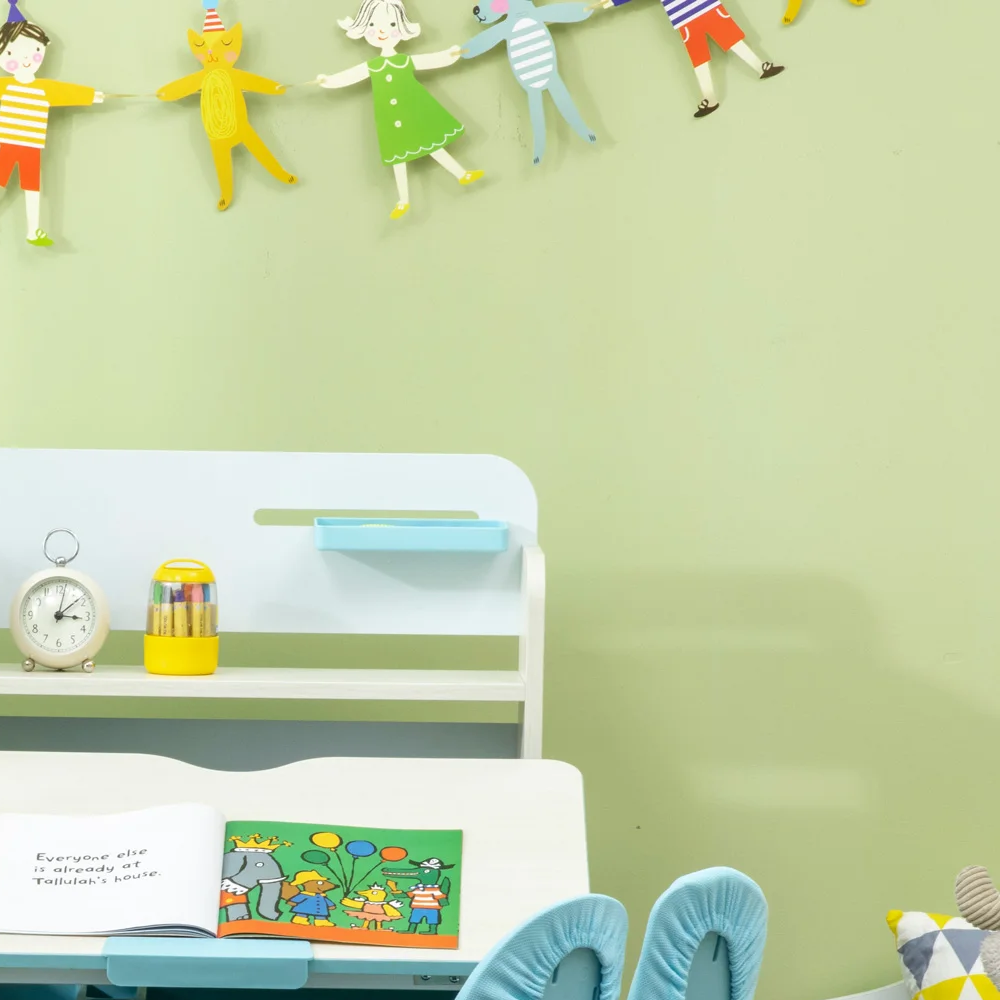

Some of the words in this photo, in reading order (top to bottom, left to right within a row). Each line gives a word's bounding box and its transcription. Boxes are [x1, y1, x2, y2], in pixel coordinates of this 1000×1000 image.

[55, 585, 64, 595] 12
[80, 598, 86, 607] 2
[27, 610, 34, 621] 9
[84, 611, 91, 622] 3
[31, 623, 39, 633] 8
[80, 624, 86, 633] 4
[43, 633, 49, 643] 7
[56, 638, 62, 648] 6
[70, 634, 76, 644] 5
[36, 853, 110, 863] Everyone
[117, 848, 148, 859] else
[53, 864, 115, 874] already
[122, 860, 142, 869] at
[32, 876, 107, 886] Tallulah's
[114, 870, 162, 883] house.
